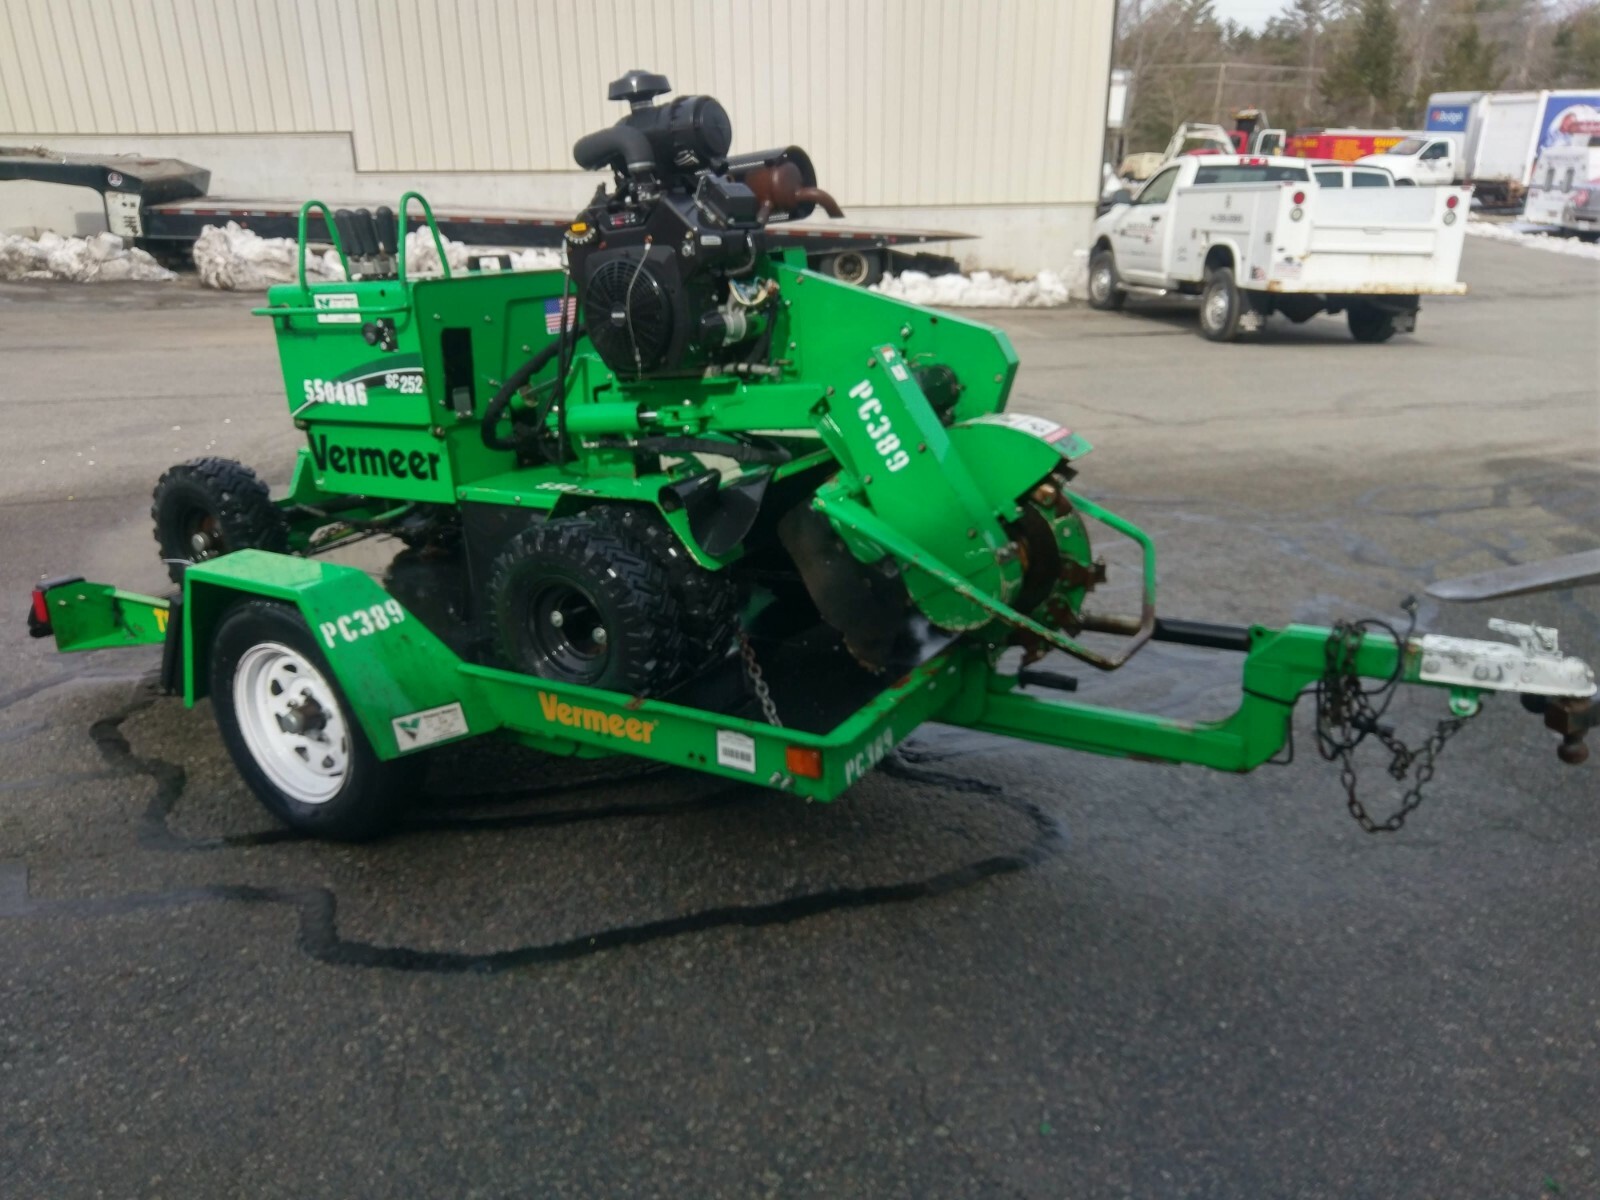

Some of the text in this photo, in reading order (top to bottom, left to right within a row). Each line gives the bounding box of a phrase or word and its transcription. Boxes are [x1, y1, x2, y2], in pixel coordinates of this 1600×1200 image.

[303, 378, 368, 406] 550486
[385, 374, 423, 394] SC 252
[848, 379, 910, 472] PC389
[308, 433, 440, 482] Vermeer
[319, 598, 405, 649] PC389
[538, 691, 654, 744] Vermeer
